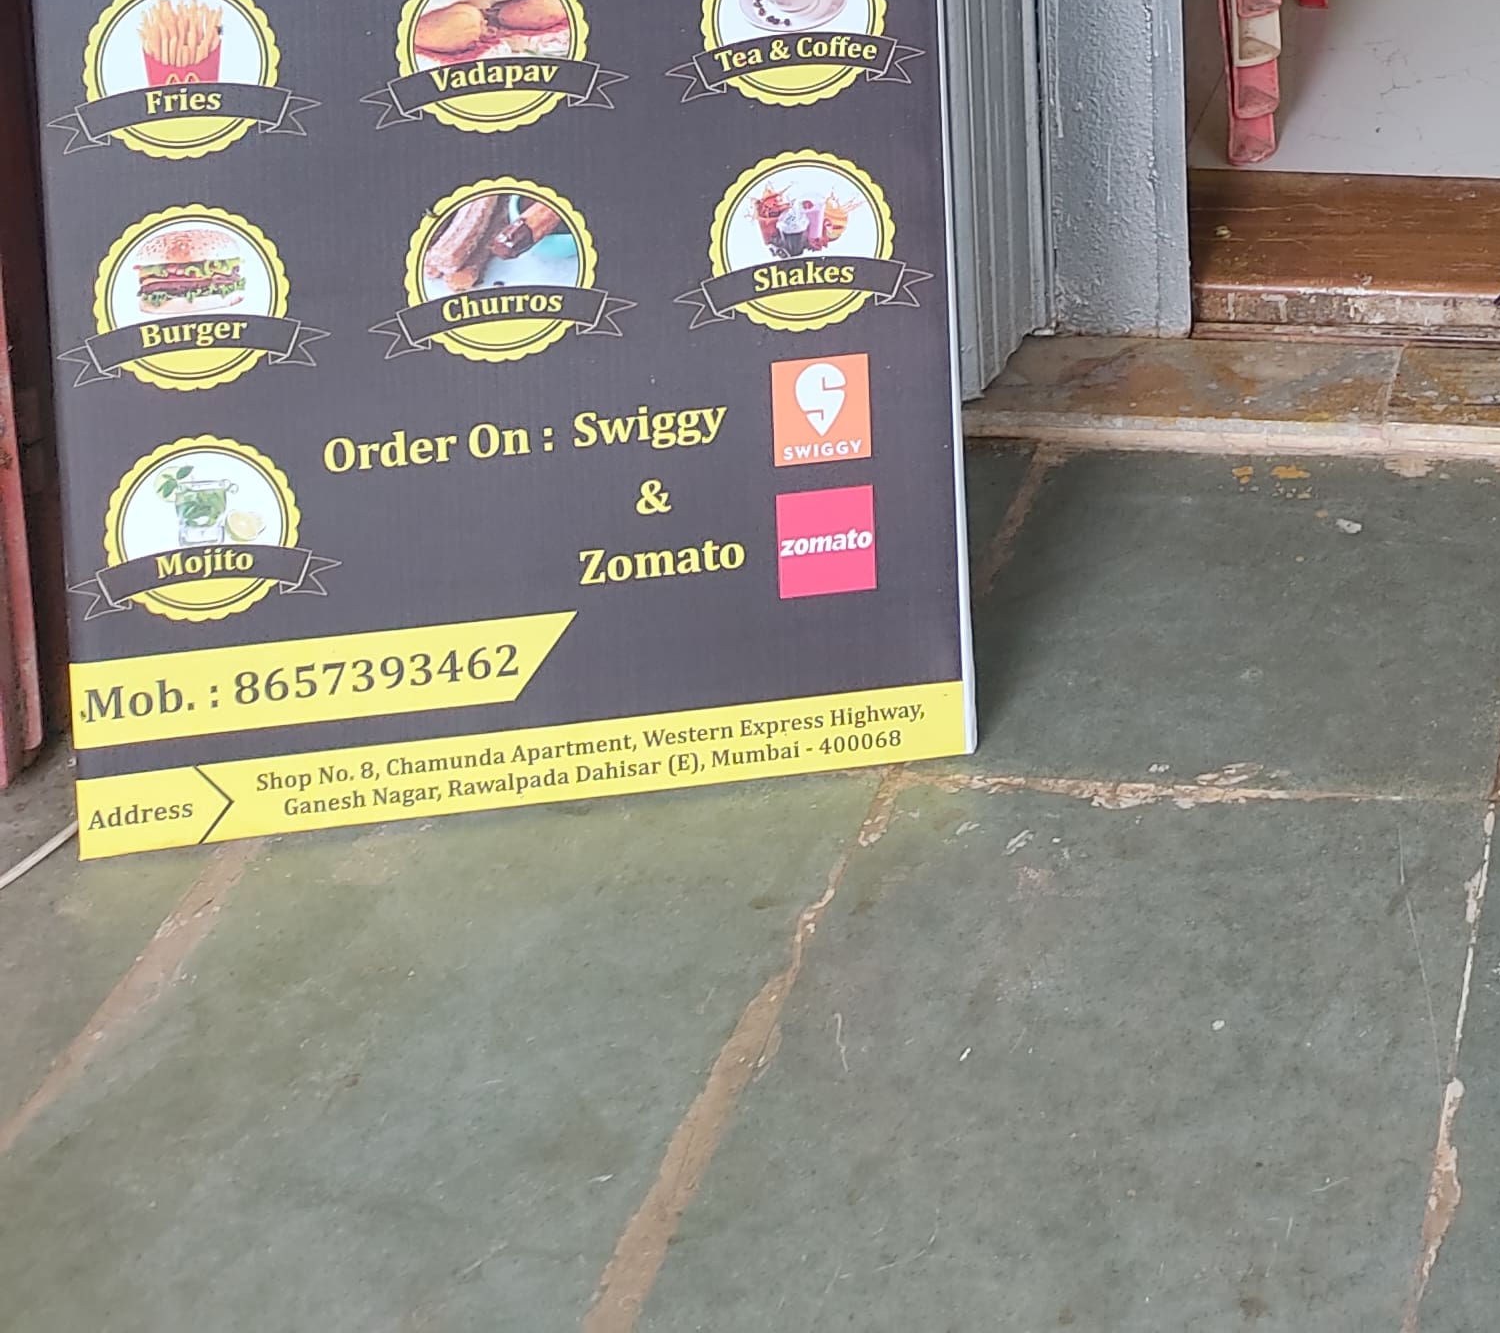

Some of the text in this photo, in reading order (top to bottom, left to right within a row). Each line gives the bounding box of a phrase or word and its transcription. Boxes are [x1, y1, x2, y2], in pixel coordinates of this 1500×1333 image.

[715, 35, 879, 71] Tea & Coffee
[430, 60, 560, 96] Vadapav
[145, 88, 222, 114] Fries
[752, 259, 856, 292] Shakes
[441, 288, 564, 318] Churros
[140, 314, 248, 353] Burger
[323, 431, 457, 473] Order
[469, 423, 530, 458] On
[573, 405, 728, 449] Swiggy
[783, 439, 863, 461] SWIGGY
[636, 479, 672, 515] &
[780, 527, 873, 557] zomato
[154, 546, 255, 581] Mojito
[579, 539, 746, 586] Zomato
[84, 680, 195, 723] Mob.
[234, 643, 519, 706] 8657393462
[256, 701, 926, 793] Shop No. 8, Chamunda Apartment, Western Express Highway,
[284, 790, 366, 816] Ganesh
[372, 784, 442, 809] Nagar,
[448, 767, 569, 798] Rawalpada
[576, 761, 661, 784] Dahisar
[669, 751, 706, 776] (E),
[711, 741, 800, 767] Mumbai
[819, 730, 901, 755] 400068
[88, 803, 194, 831] Address
